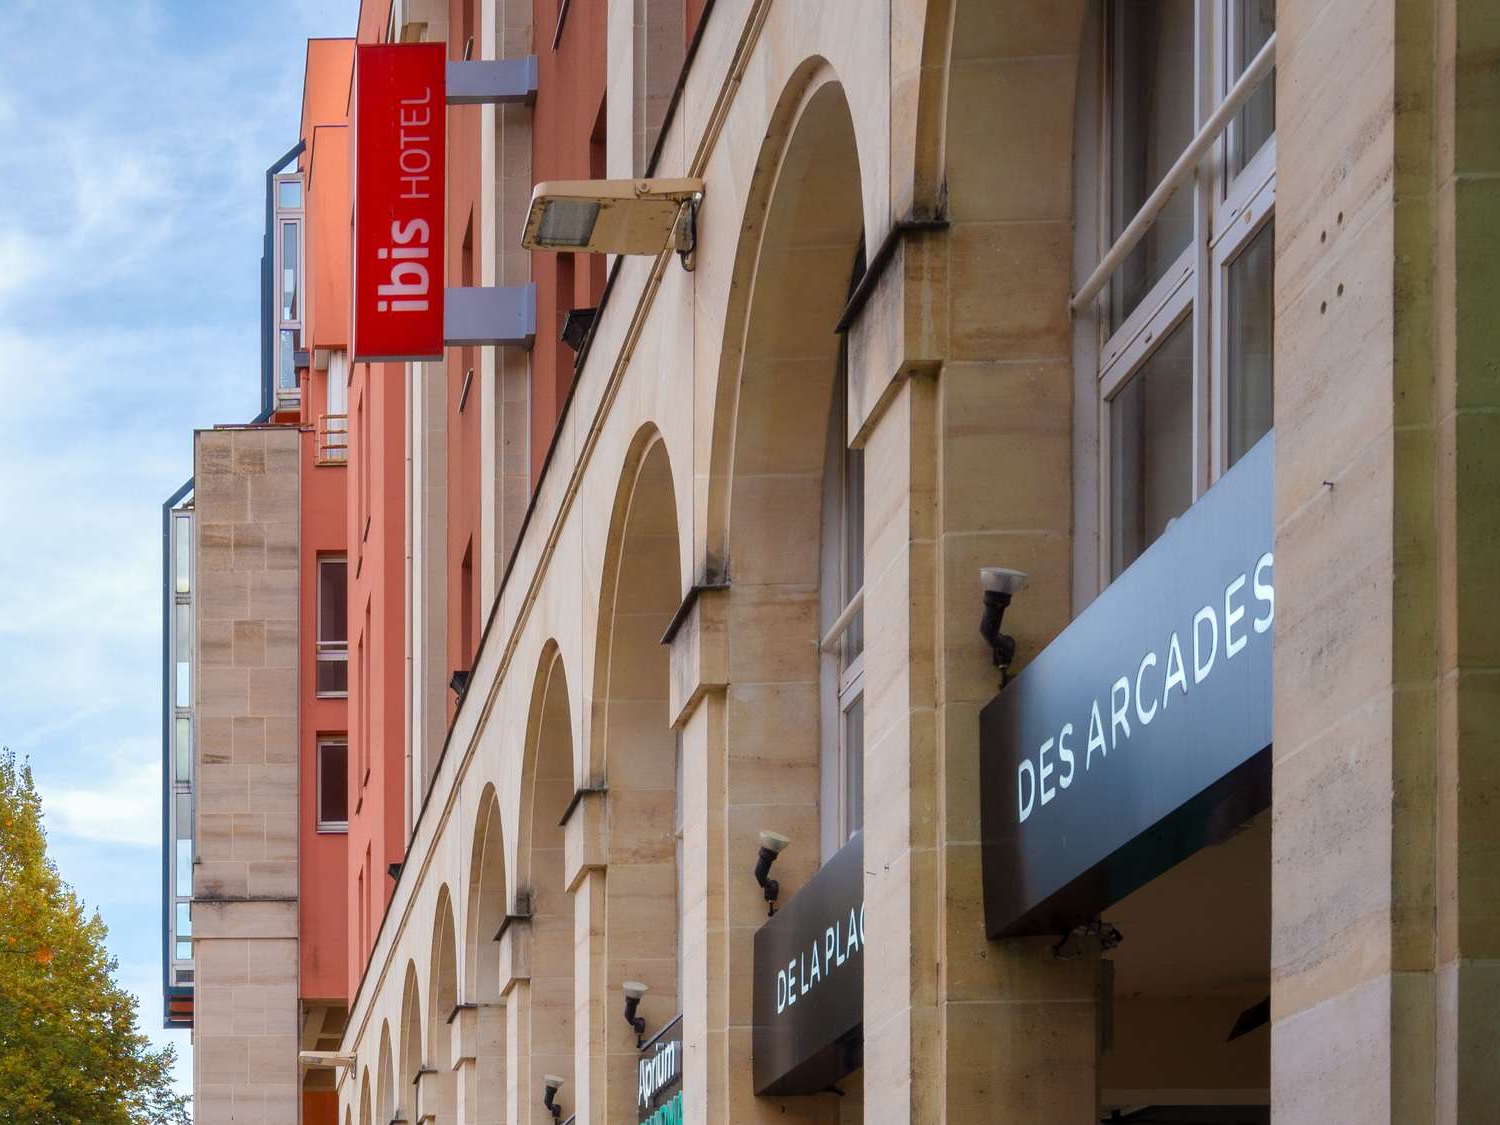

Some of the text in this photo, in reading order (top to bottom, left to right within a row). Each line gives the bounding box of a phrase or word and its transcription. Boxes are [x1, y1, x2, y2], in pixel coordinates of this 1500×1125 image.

[377, 86, 431, 312] ibis HOTEL
[1017, 551, 1274, 824] DES ARCADES
[777, 958, 797, 1015] DE
[801, 939, 821, 995] LA
[638, 1041, 680, 1109] Aprium
